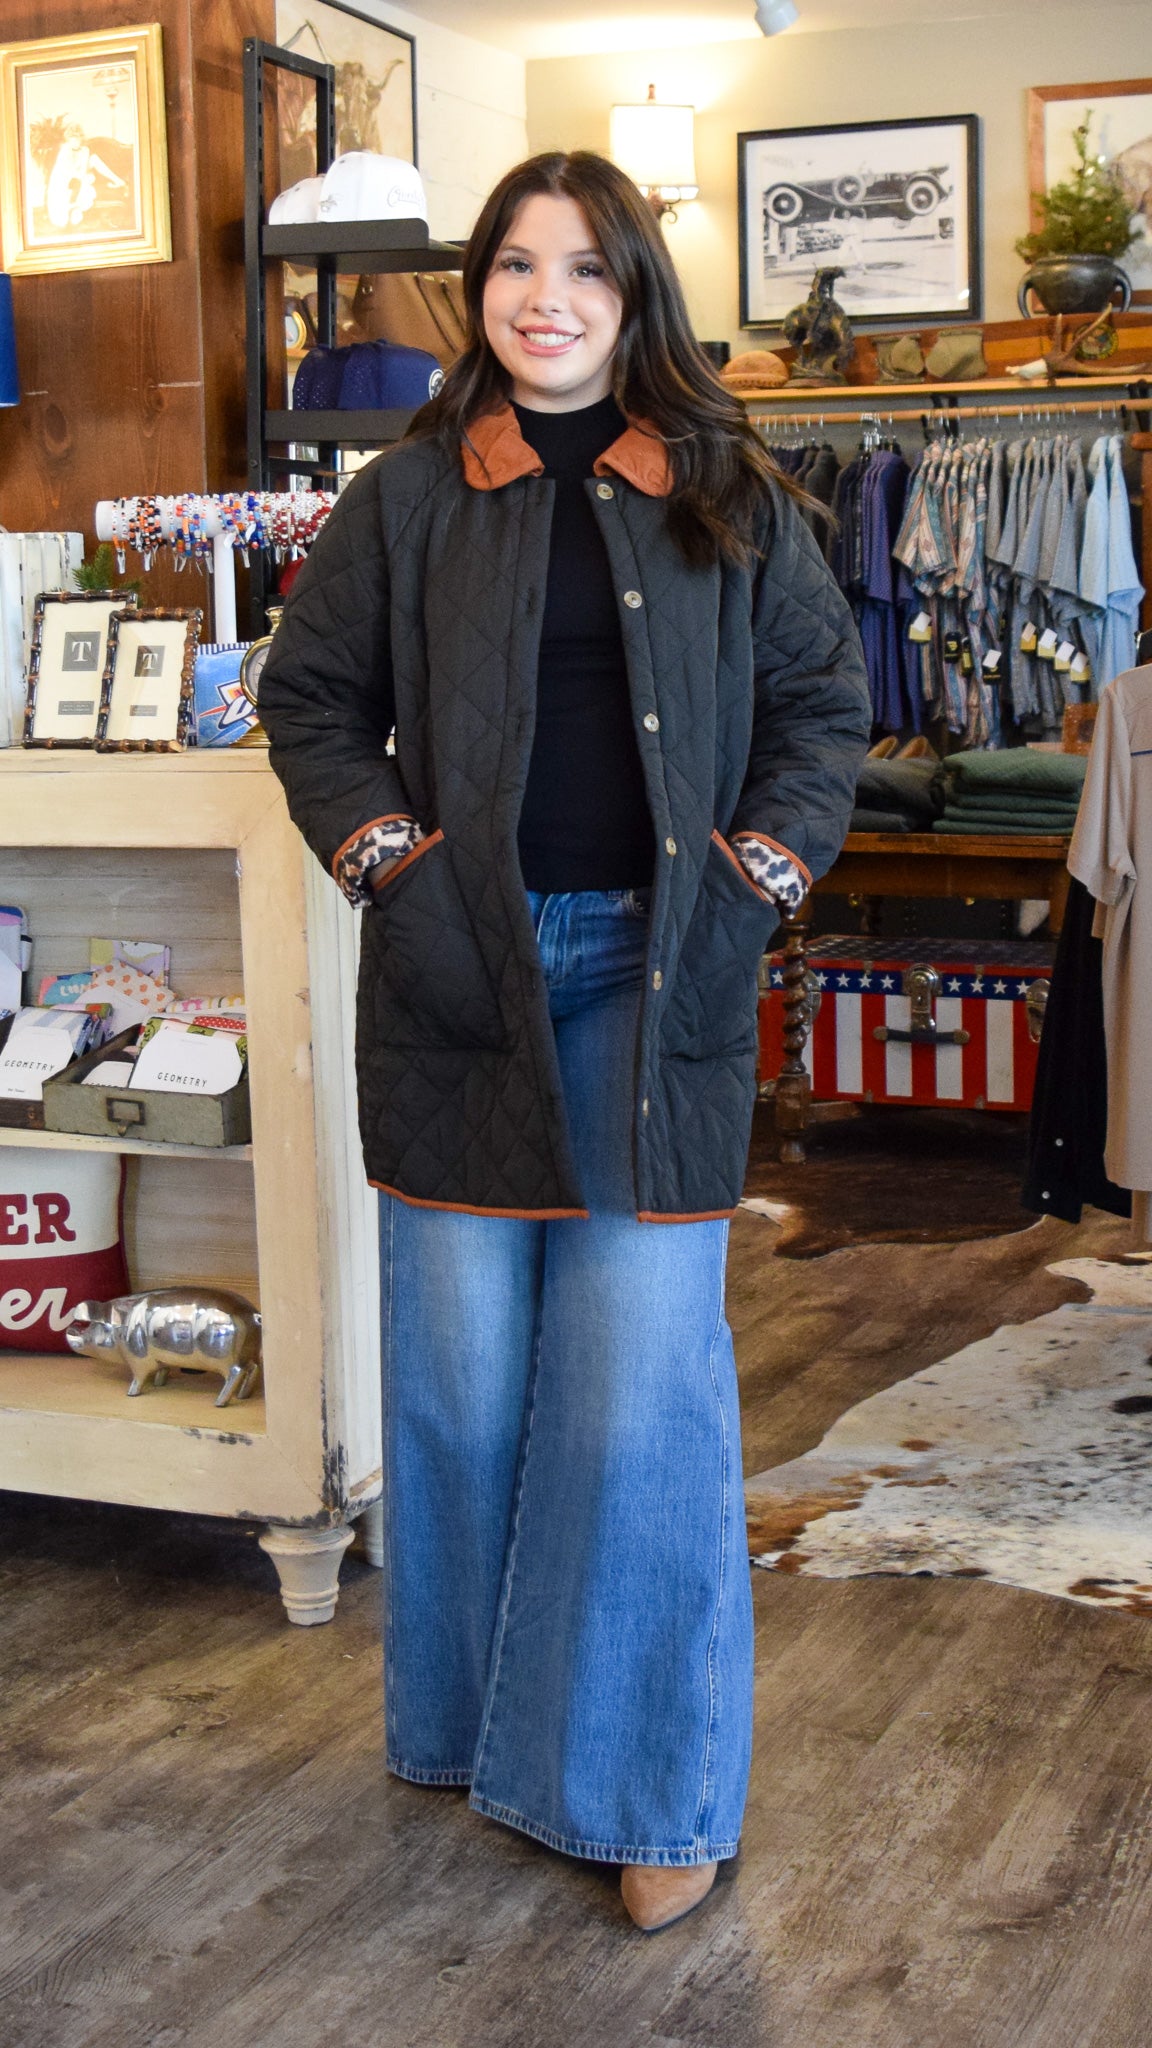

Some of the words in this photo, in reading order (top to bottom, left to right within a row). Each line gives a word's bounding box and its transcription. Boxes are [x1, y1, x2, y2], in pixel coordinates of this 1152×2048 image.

[71, 641, 92, 662] T
[142, 653, 159, 670] T
[4, 1059, 56, 1072] GEOMETRY
[157, 1071, 208, 1088] GEOMETRY
